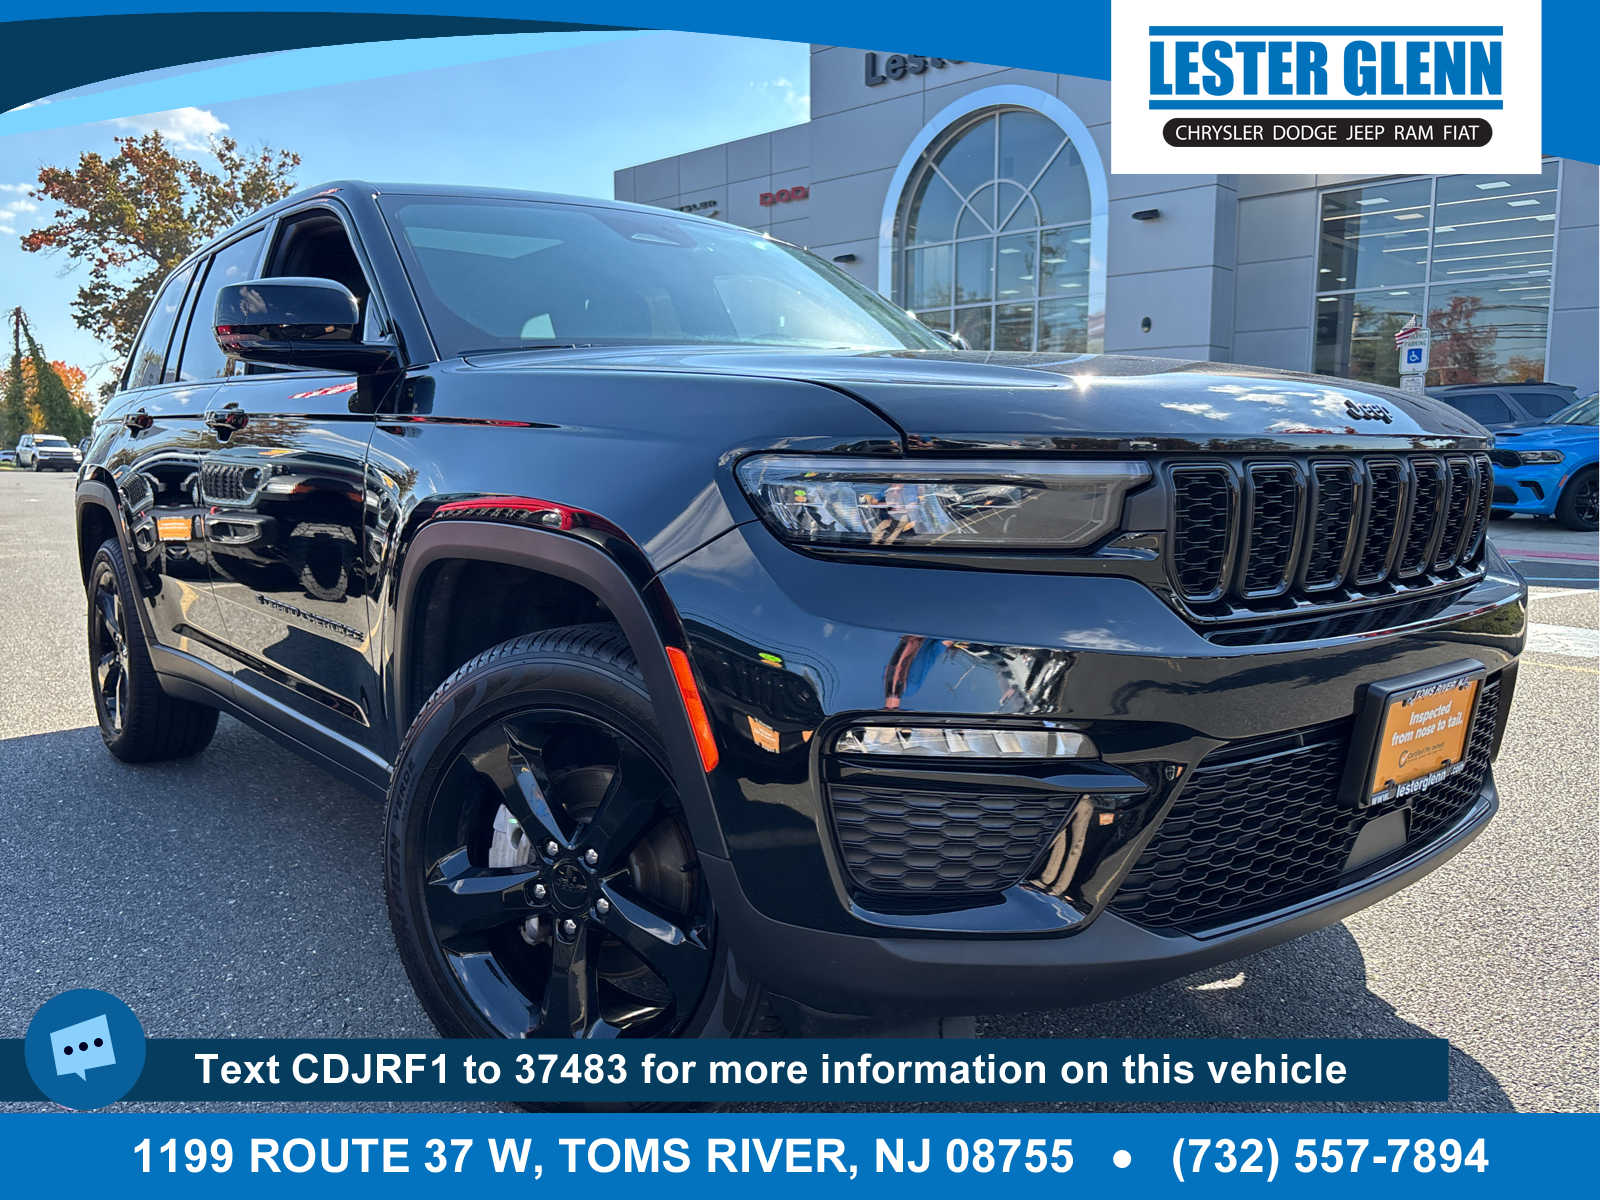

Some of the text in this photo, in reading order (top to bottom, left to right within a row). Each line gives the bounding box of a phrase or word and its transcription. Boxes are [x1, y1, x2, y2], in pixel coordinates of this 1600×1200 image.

[760, 185, 809, 206] DOD
[1344, 400, 1392, 424] Jeep
[1409, 700, 1453, 726] Inspected
[1392, 730, 1414, 746] from
[1415, 724, 1436, 738] nose
[1437, 719, 1447, 731] to
